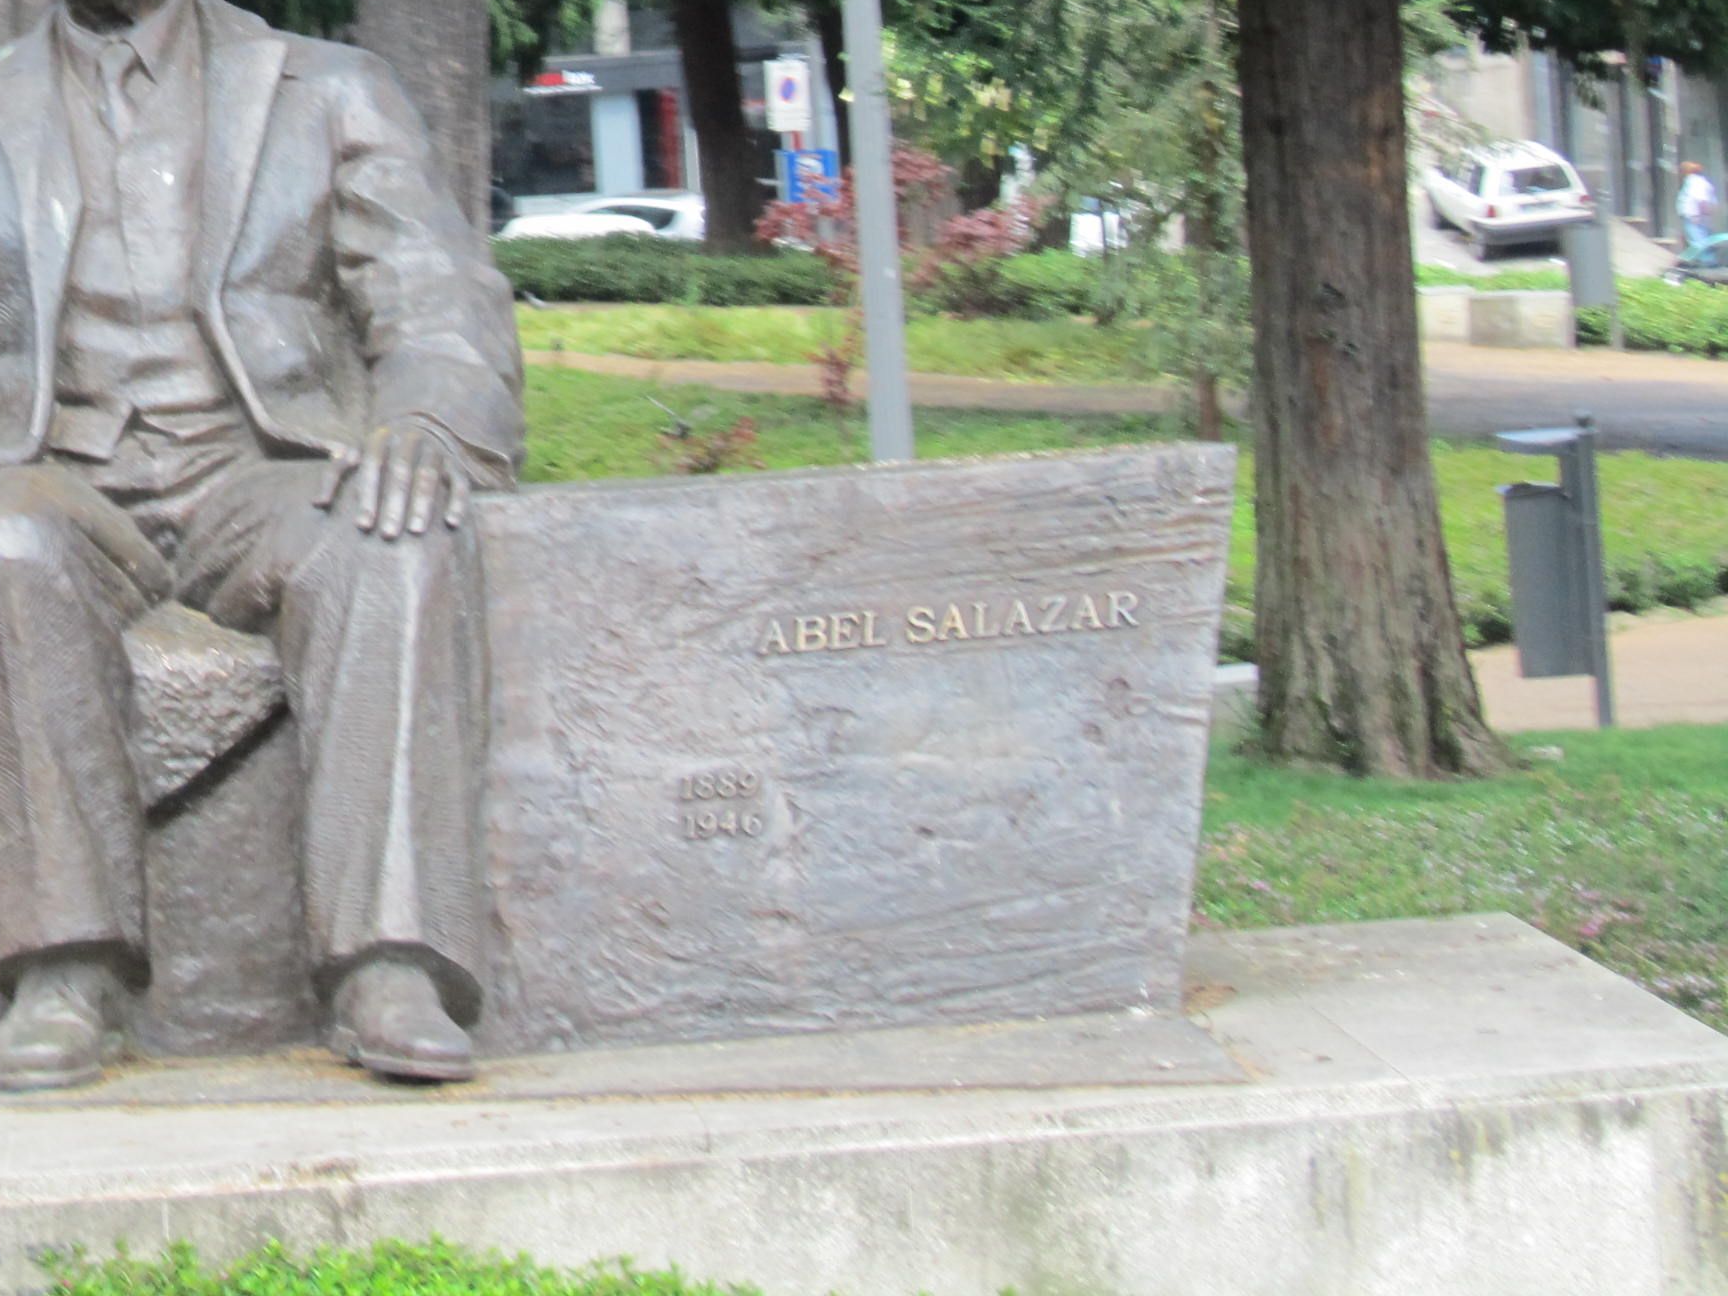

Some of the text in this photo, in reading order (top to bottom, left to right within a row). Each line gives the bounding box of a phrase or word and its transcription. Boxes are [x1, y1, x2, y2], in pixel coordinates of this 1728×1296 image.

[758, 590, 1140, 655] ABEL SALAZAR
[680, 763, 760, 801] 1889
[681, 794, 762, 839] 1946
